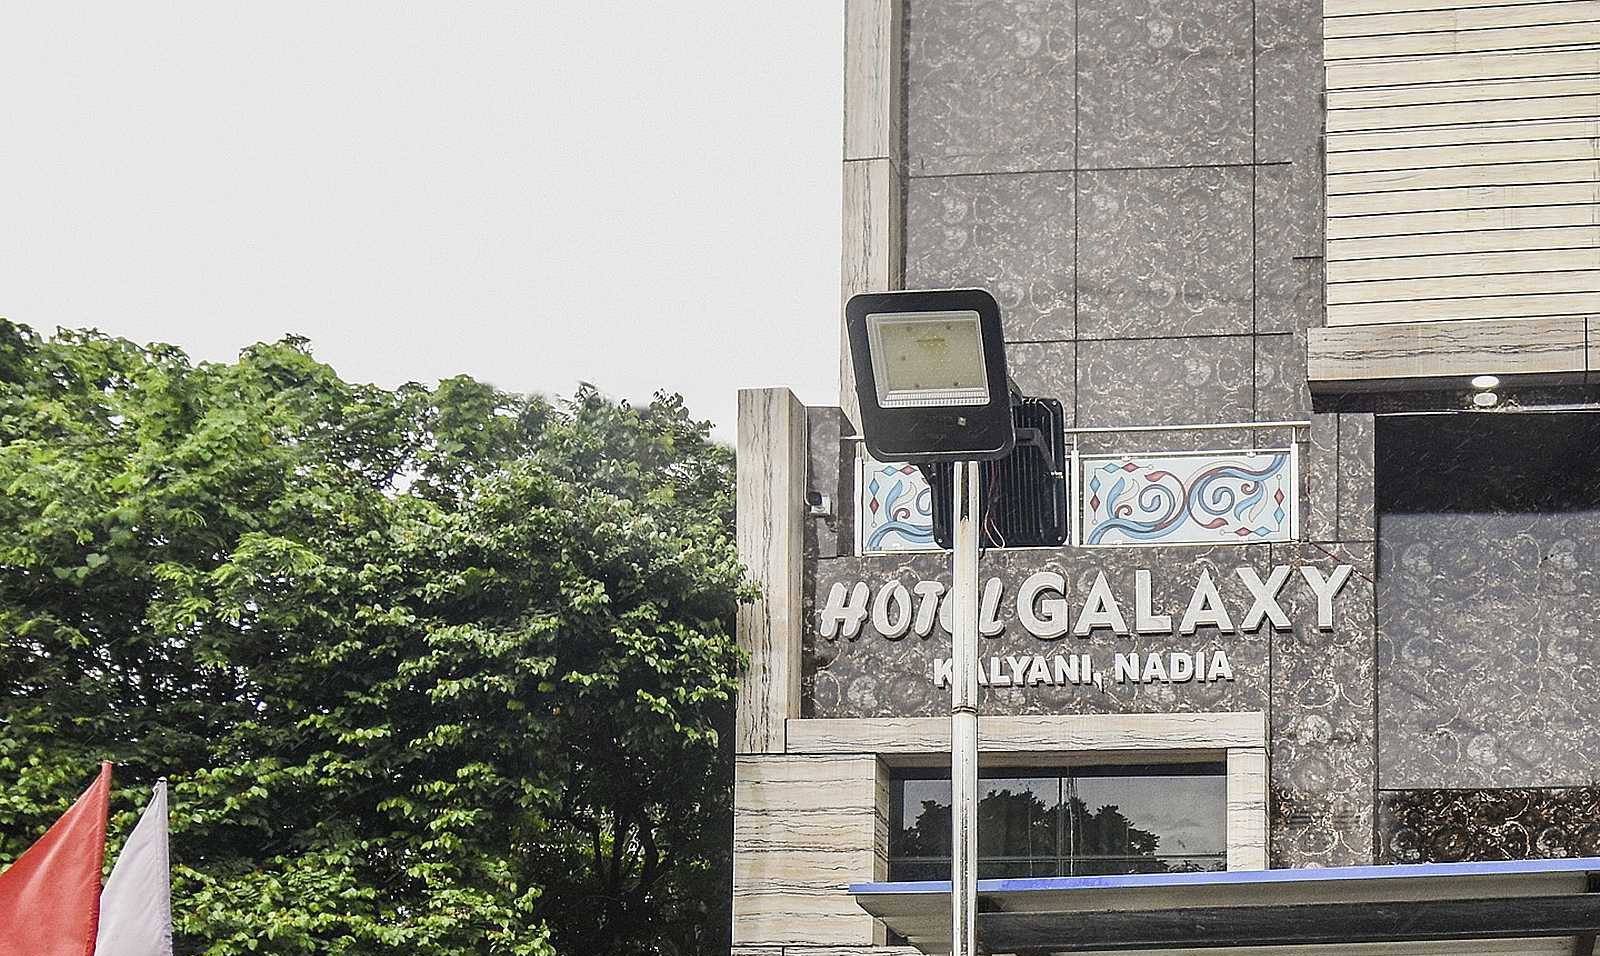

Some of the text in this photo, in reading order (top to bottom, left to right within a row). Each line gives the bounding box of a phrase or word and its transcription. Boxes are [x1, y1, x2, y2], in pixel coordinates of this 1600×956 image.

[1016, 564, 1353, 639] GALAXY
[933, 650, 1234, 693] KLYANI, NADIA
